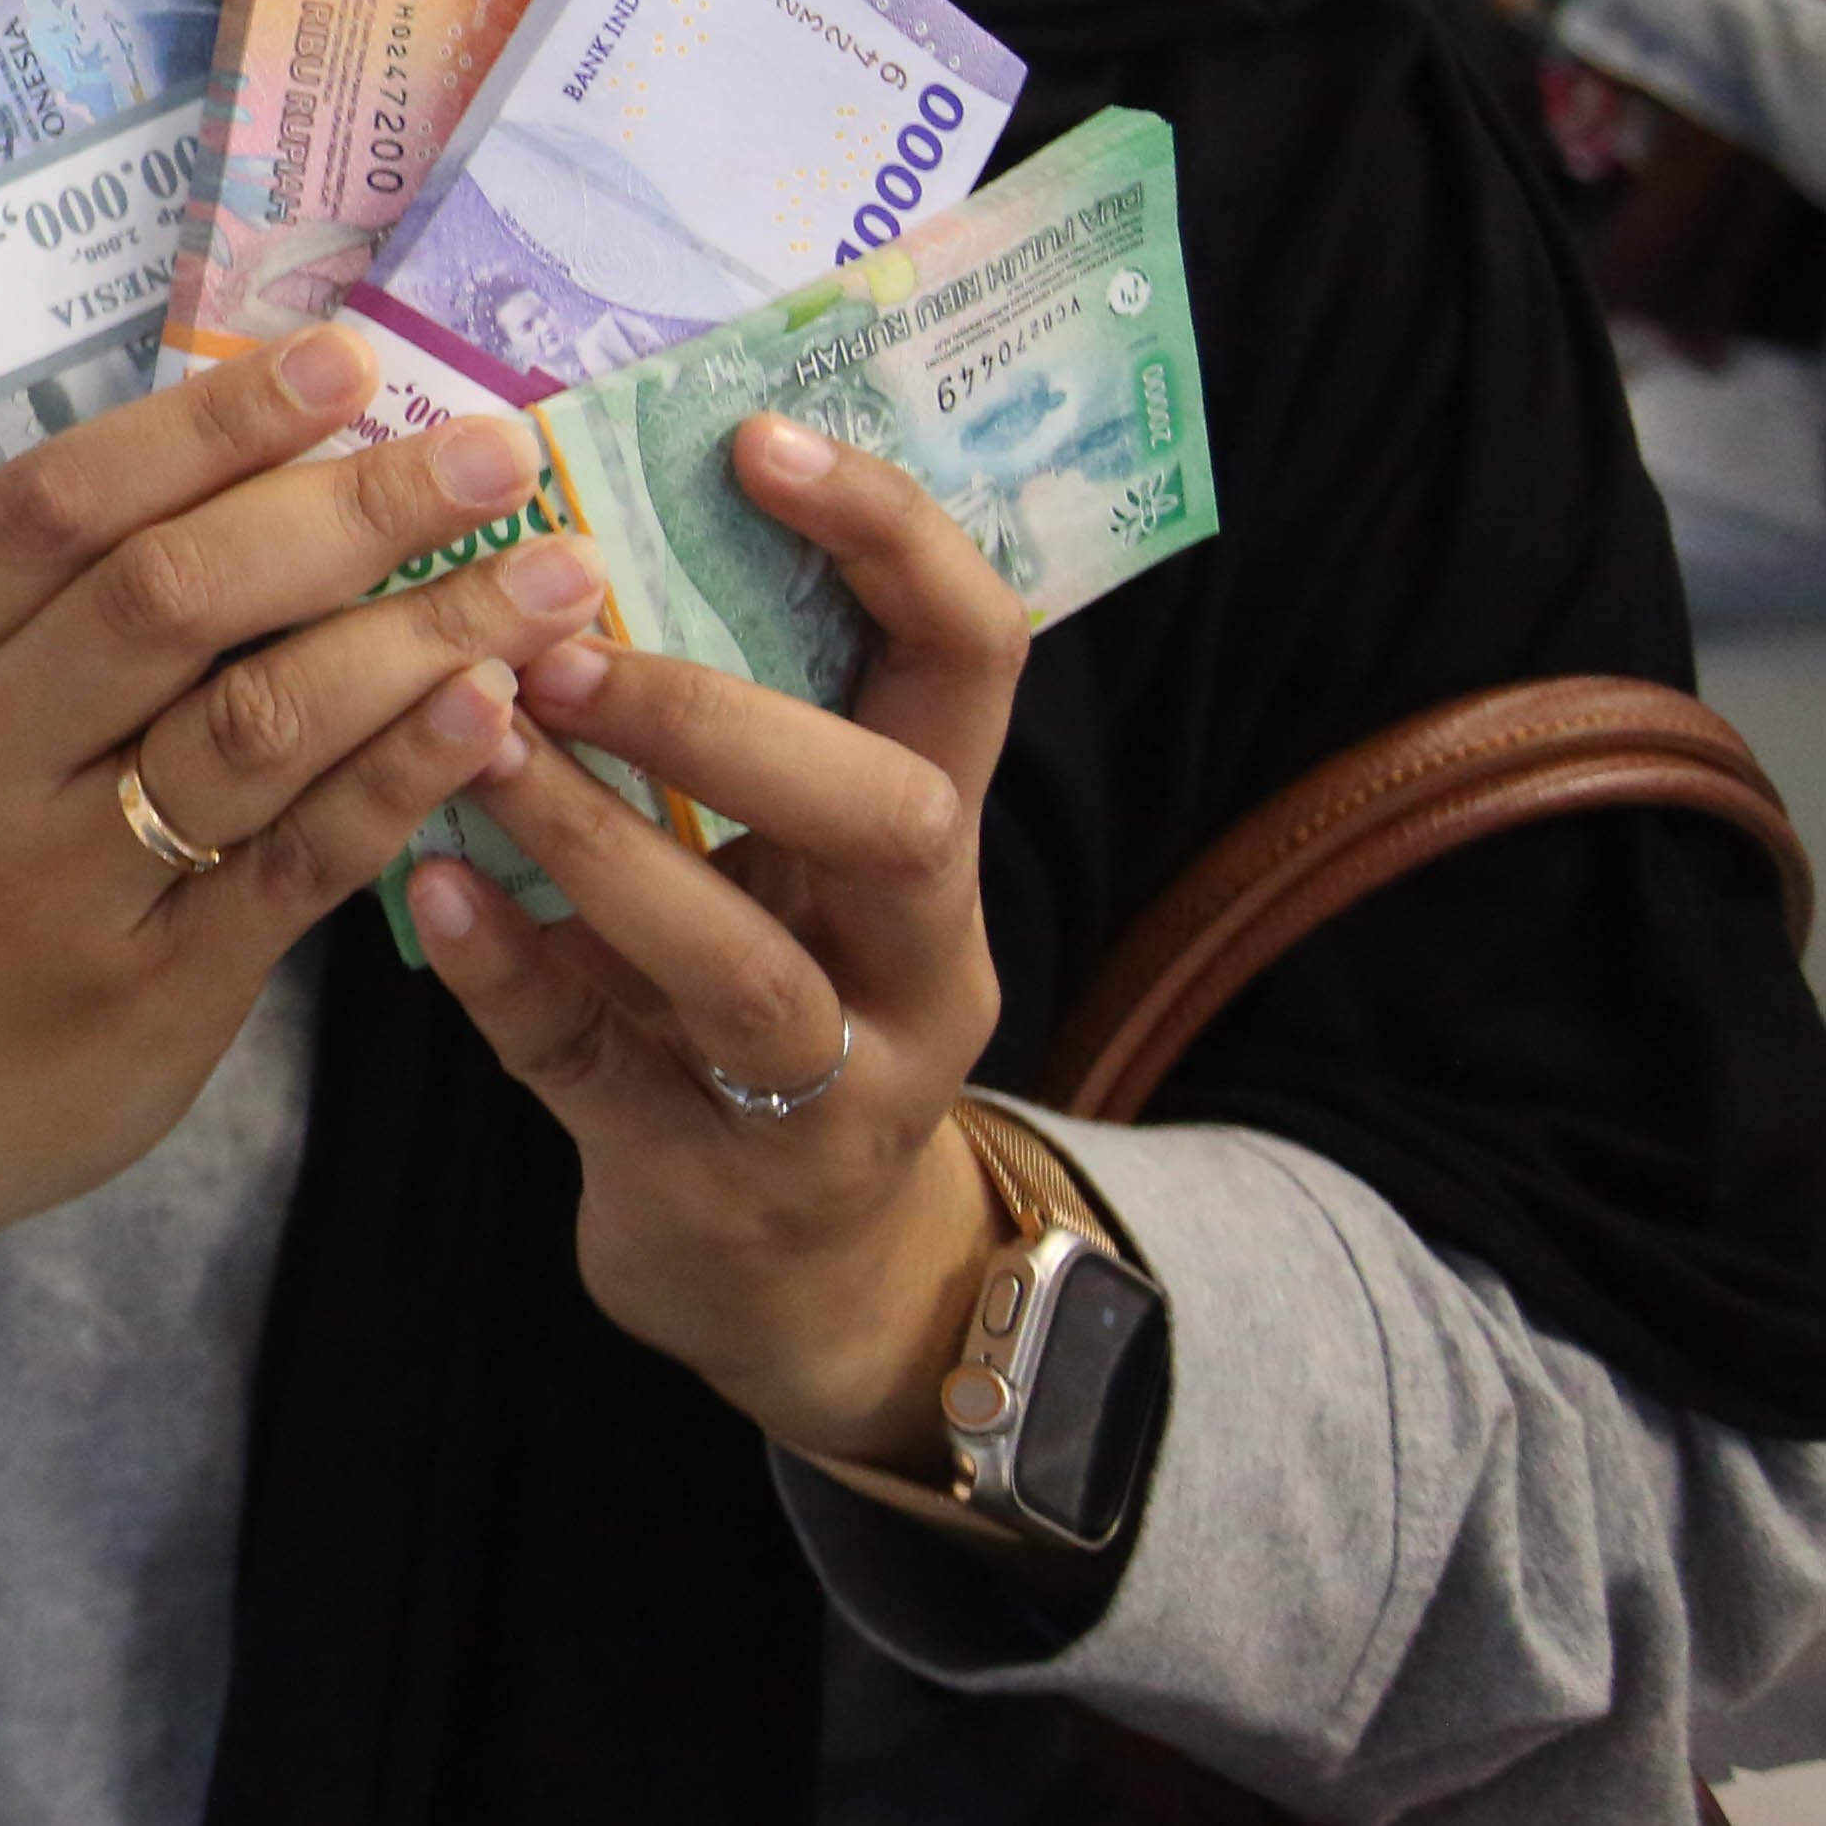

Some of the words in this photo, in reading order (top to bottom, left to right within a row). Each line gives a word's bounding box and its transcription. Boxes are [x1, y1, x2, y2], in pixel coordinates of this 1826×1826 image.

[4, 16, 66, 138] ONESIA
[289, 0, 334, 87] RIBU
[562, 22, 614, 103] BANK
[264, 90, 318, 225] RUPIAH
[51, 252, 178, 327] NESIA
[915, 276, 981, 335] RIBU
[794, 307, 910, 387] RUPIAH
